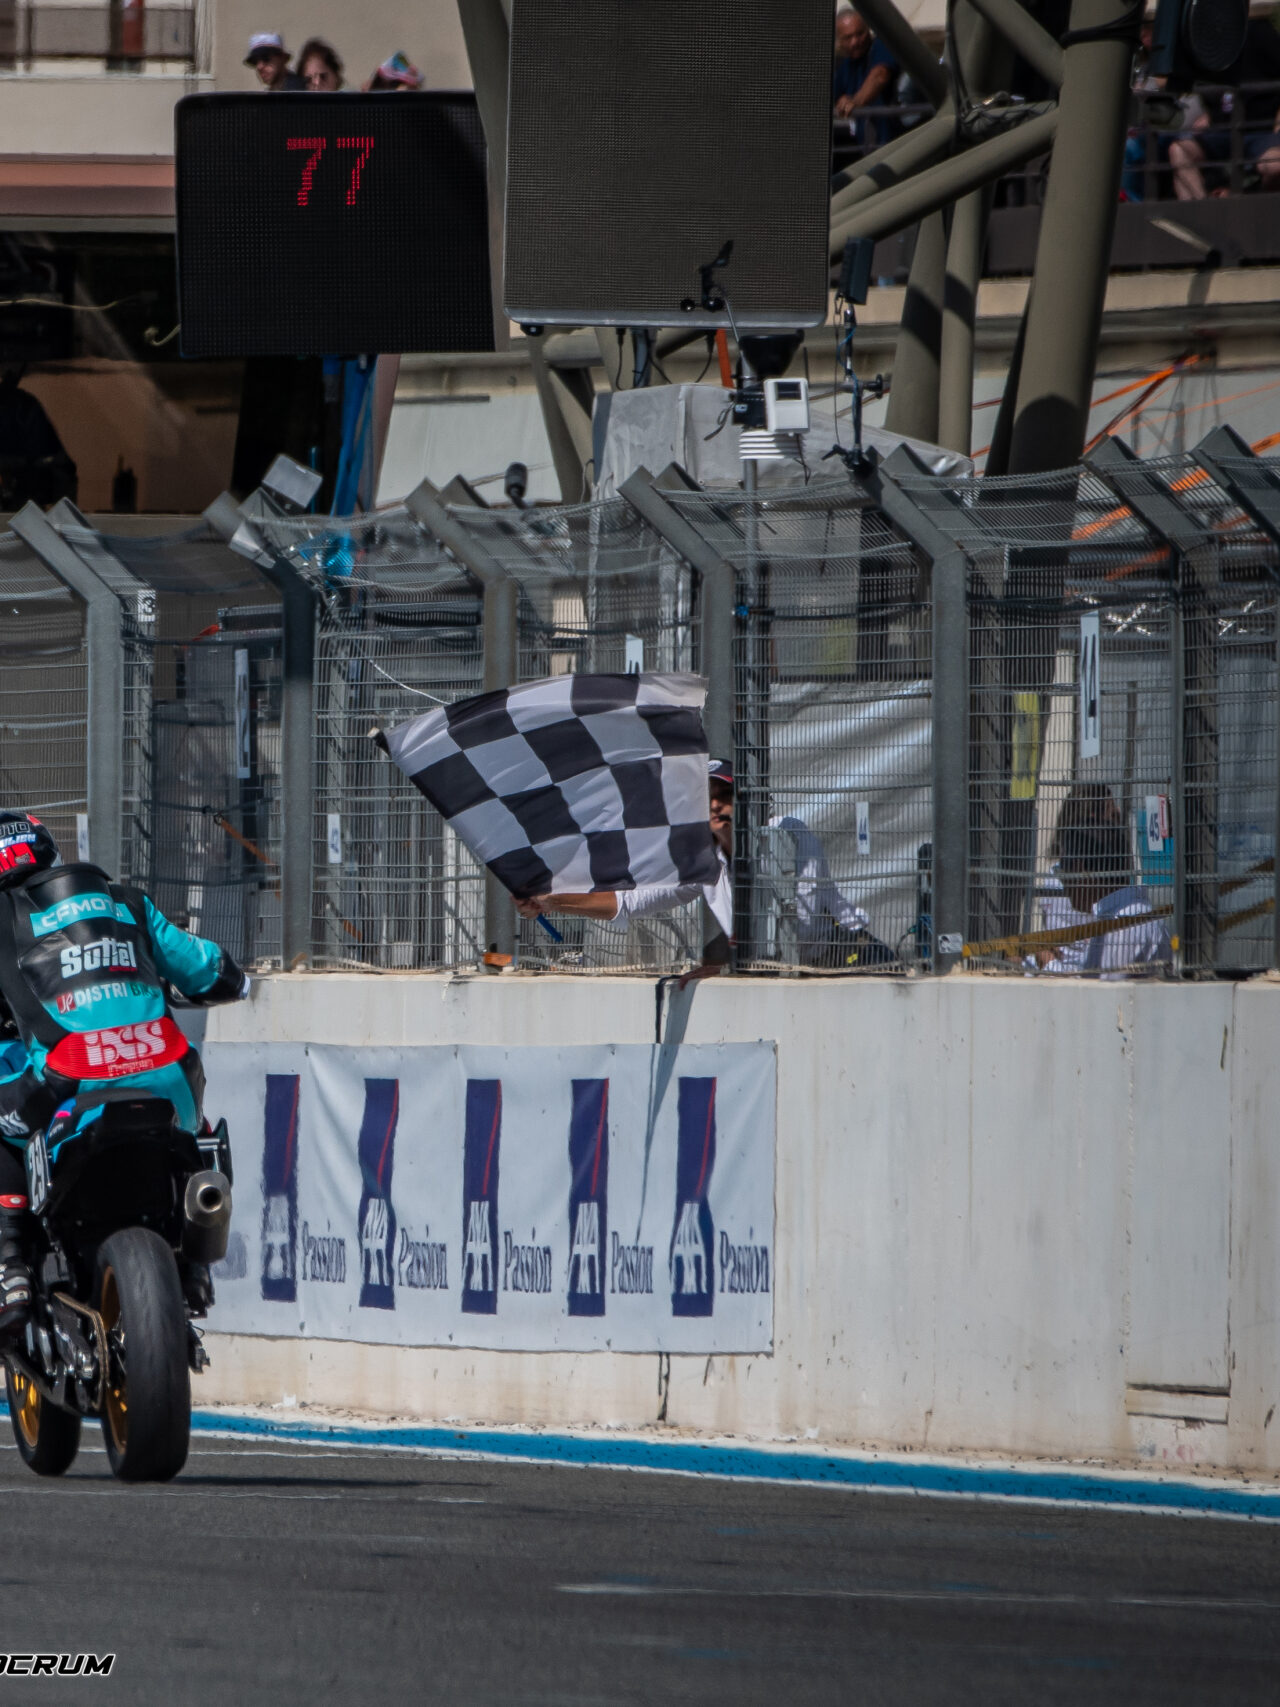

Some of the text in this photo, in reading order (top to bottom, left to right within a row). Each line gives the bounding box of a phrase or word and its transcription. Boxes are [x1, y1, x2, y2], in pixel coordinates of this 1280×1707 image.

[286, 136, 375, 206] 77
[1081, 633, 1097, 741] 14
[1150, 812, 1160, 842] 45
[74, 982, 129, 1007] DISTRI
[503, 1226, 552, 1294] Passion
[610, 1230, 654, 1294] Passion
[719, 1225, 770, 1294] Passion
